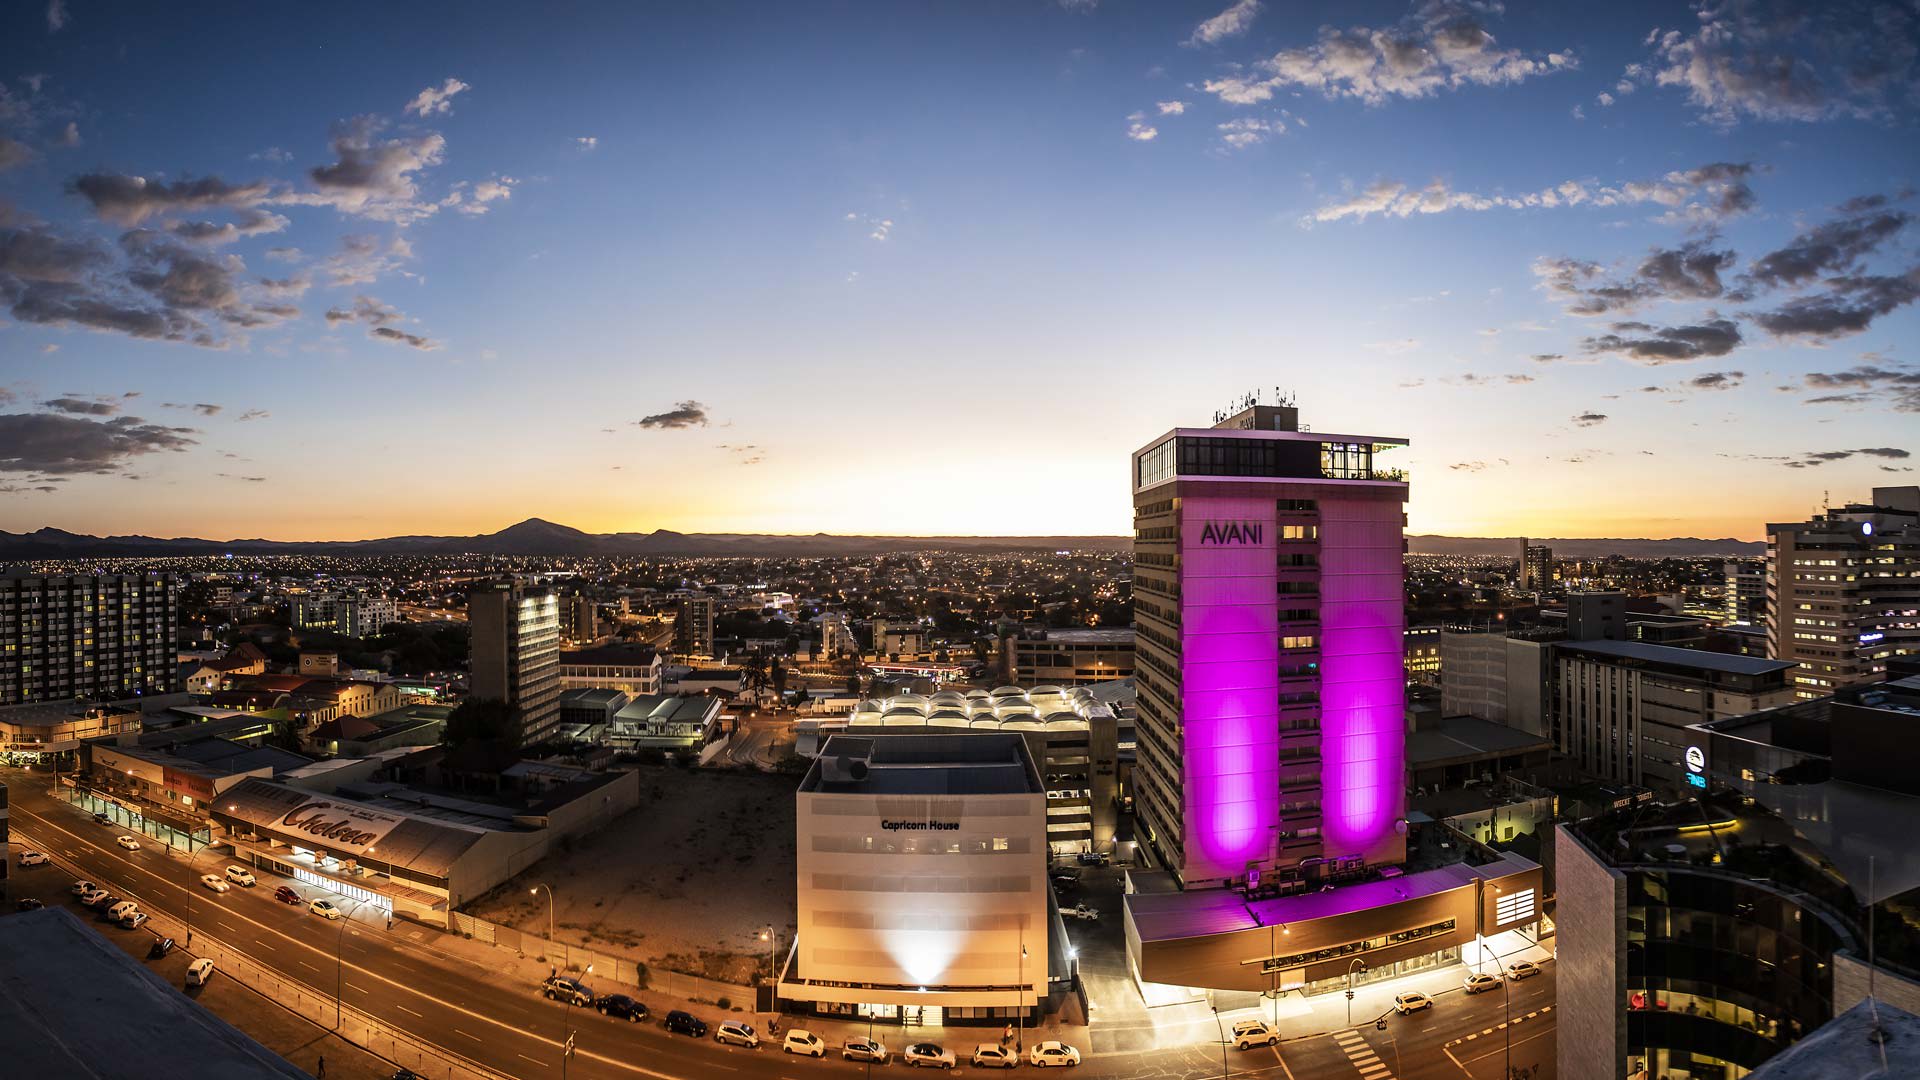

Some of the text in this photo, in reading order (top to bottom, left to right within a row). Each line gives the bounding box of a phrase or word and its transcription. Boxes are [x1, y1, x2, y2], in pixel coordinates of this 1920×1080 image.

[1200, 521, 1262, 545] AVANI
[282, 802, 377, 846] Chelsea
[881, 819, 960, 832] Capricorn House
